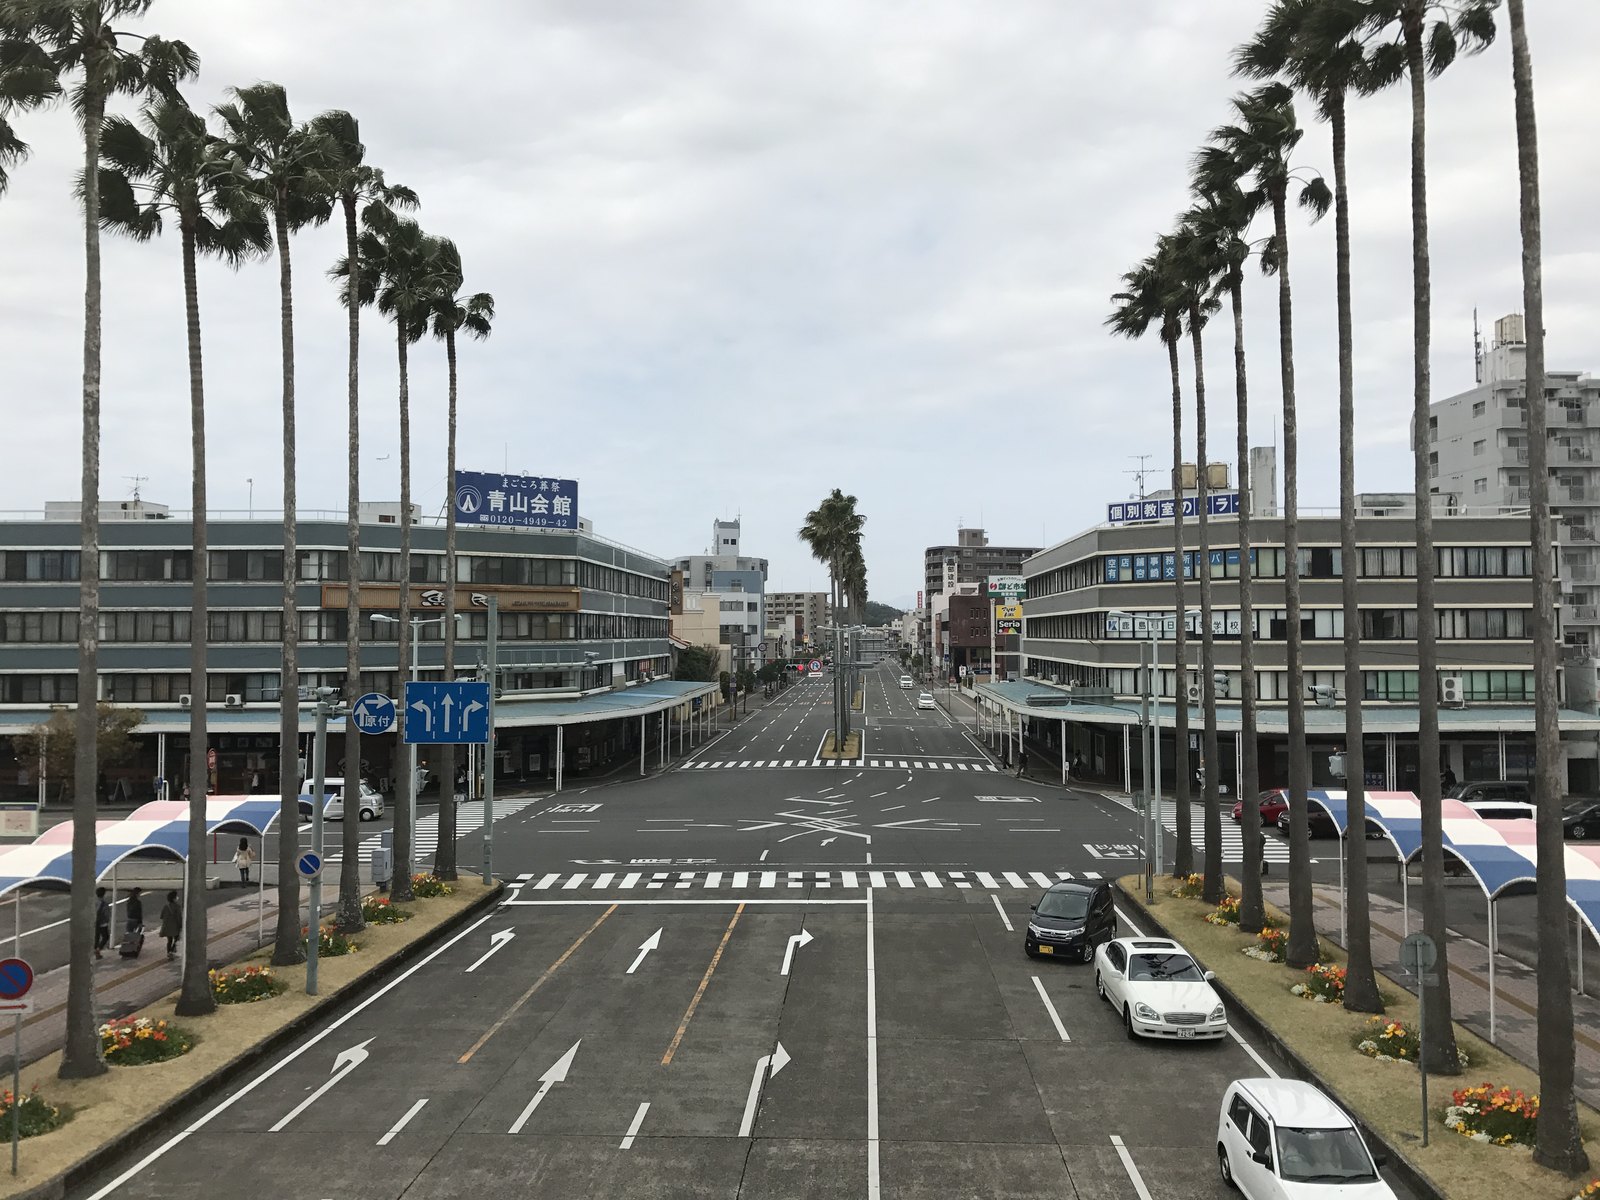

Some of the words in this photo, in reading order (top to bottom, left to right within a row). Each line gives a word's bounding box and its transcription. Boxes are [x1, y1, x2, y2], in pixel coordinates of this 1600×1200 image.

[502, 477, 560, 492] まごころ葬祭
[487, 490, 572, 516] 青山会館
[1110, 497, 1242, 520] 個別教室のラ
[490, 515, 568, 527] 0120-4949-42
[999, 620, 1020, 628] Seria
[364, 715, 390, 727] 原付
